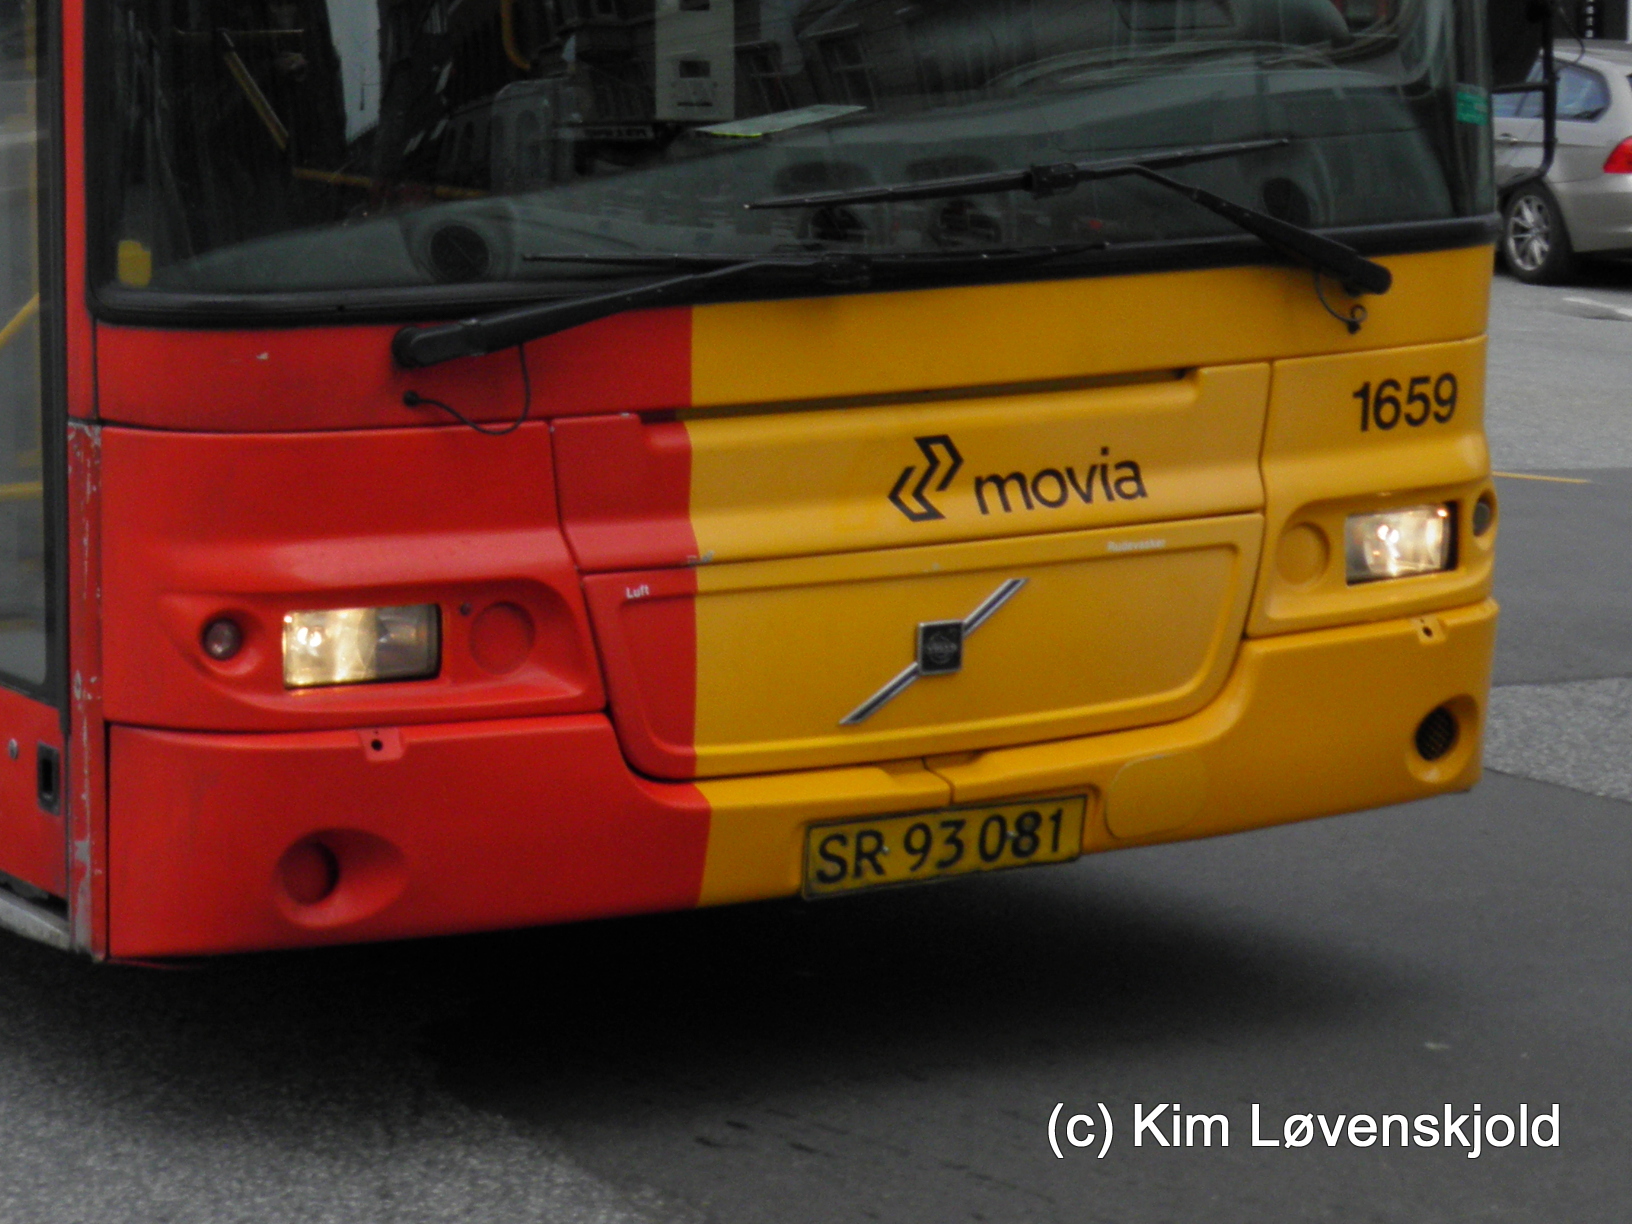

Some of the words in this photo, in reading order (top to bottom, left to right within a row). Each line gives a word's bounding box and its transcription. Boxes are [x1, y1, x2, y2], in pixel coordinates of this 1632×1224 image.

[1353, 372, 1458, 433] 1659
[973, 446, 1148, 516] movia
[626, 584, 650, 599] Luft
[816, 829, 886, 884] SR
[903, 819, 967, 872] 93
[978, 807, 1064, 863] 081
